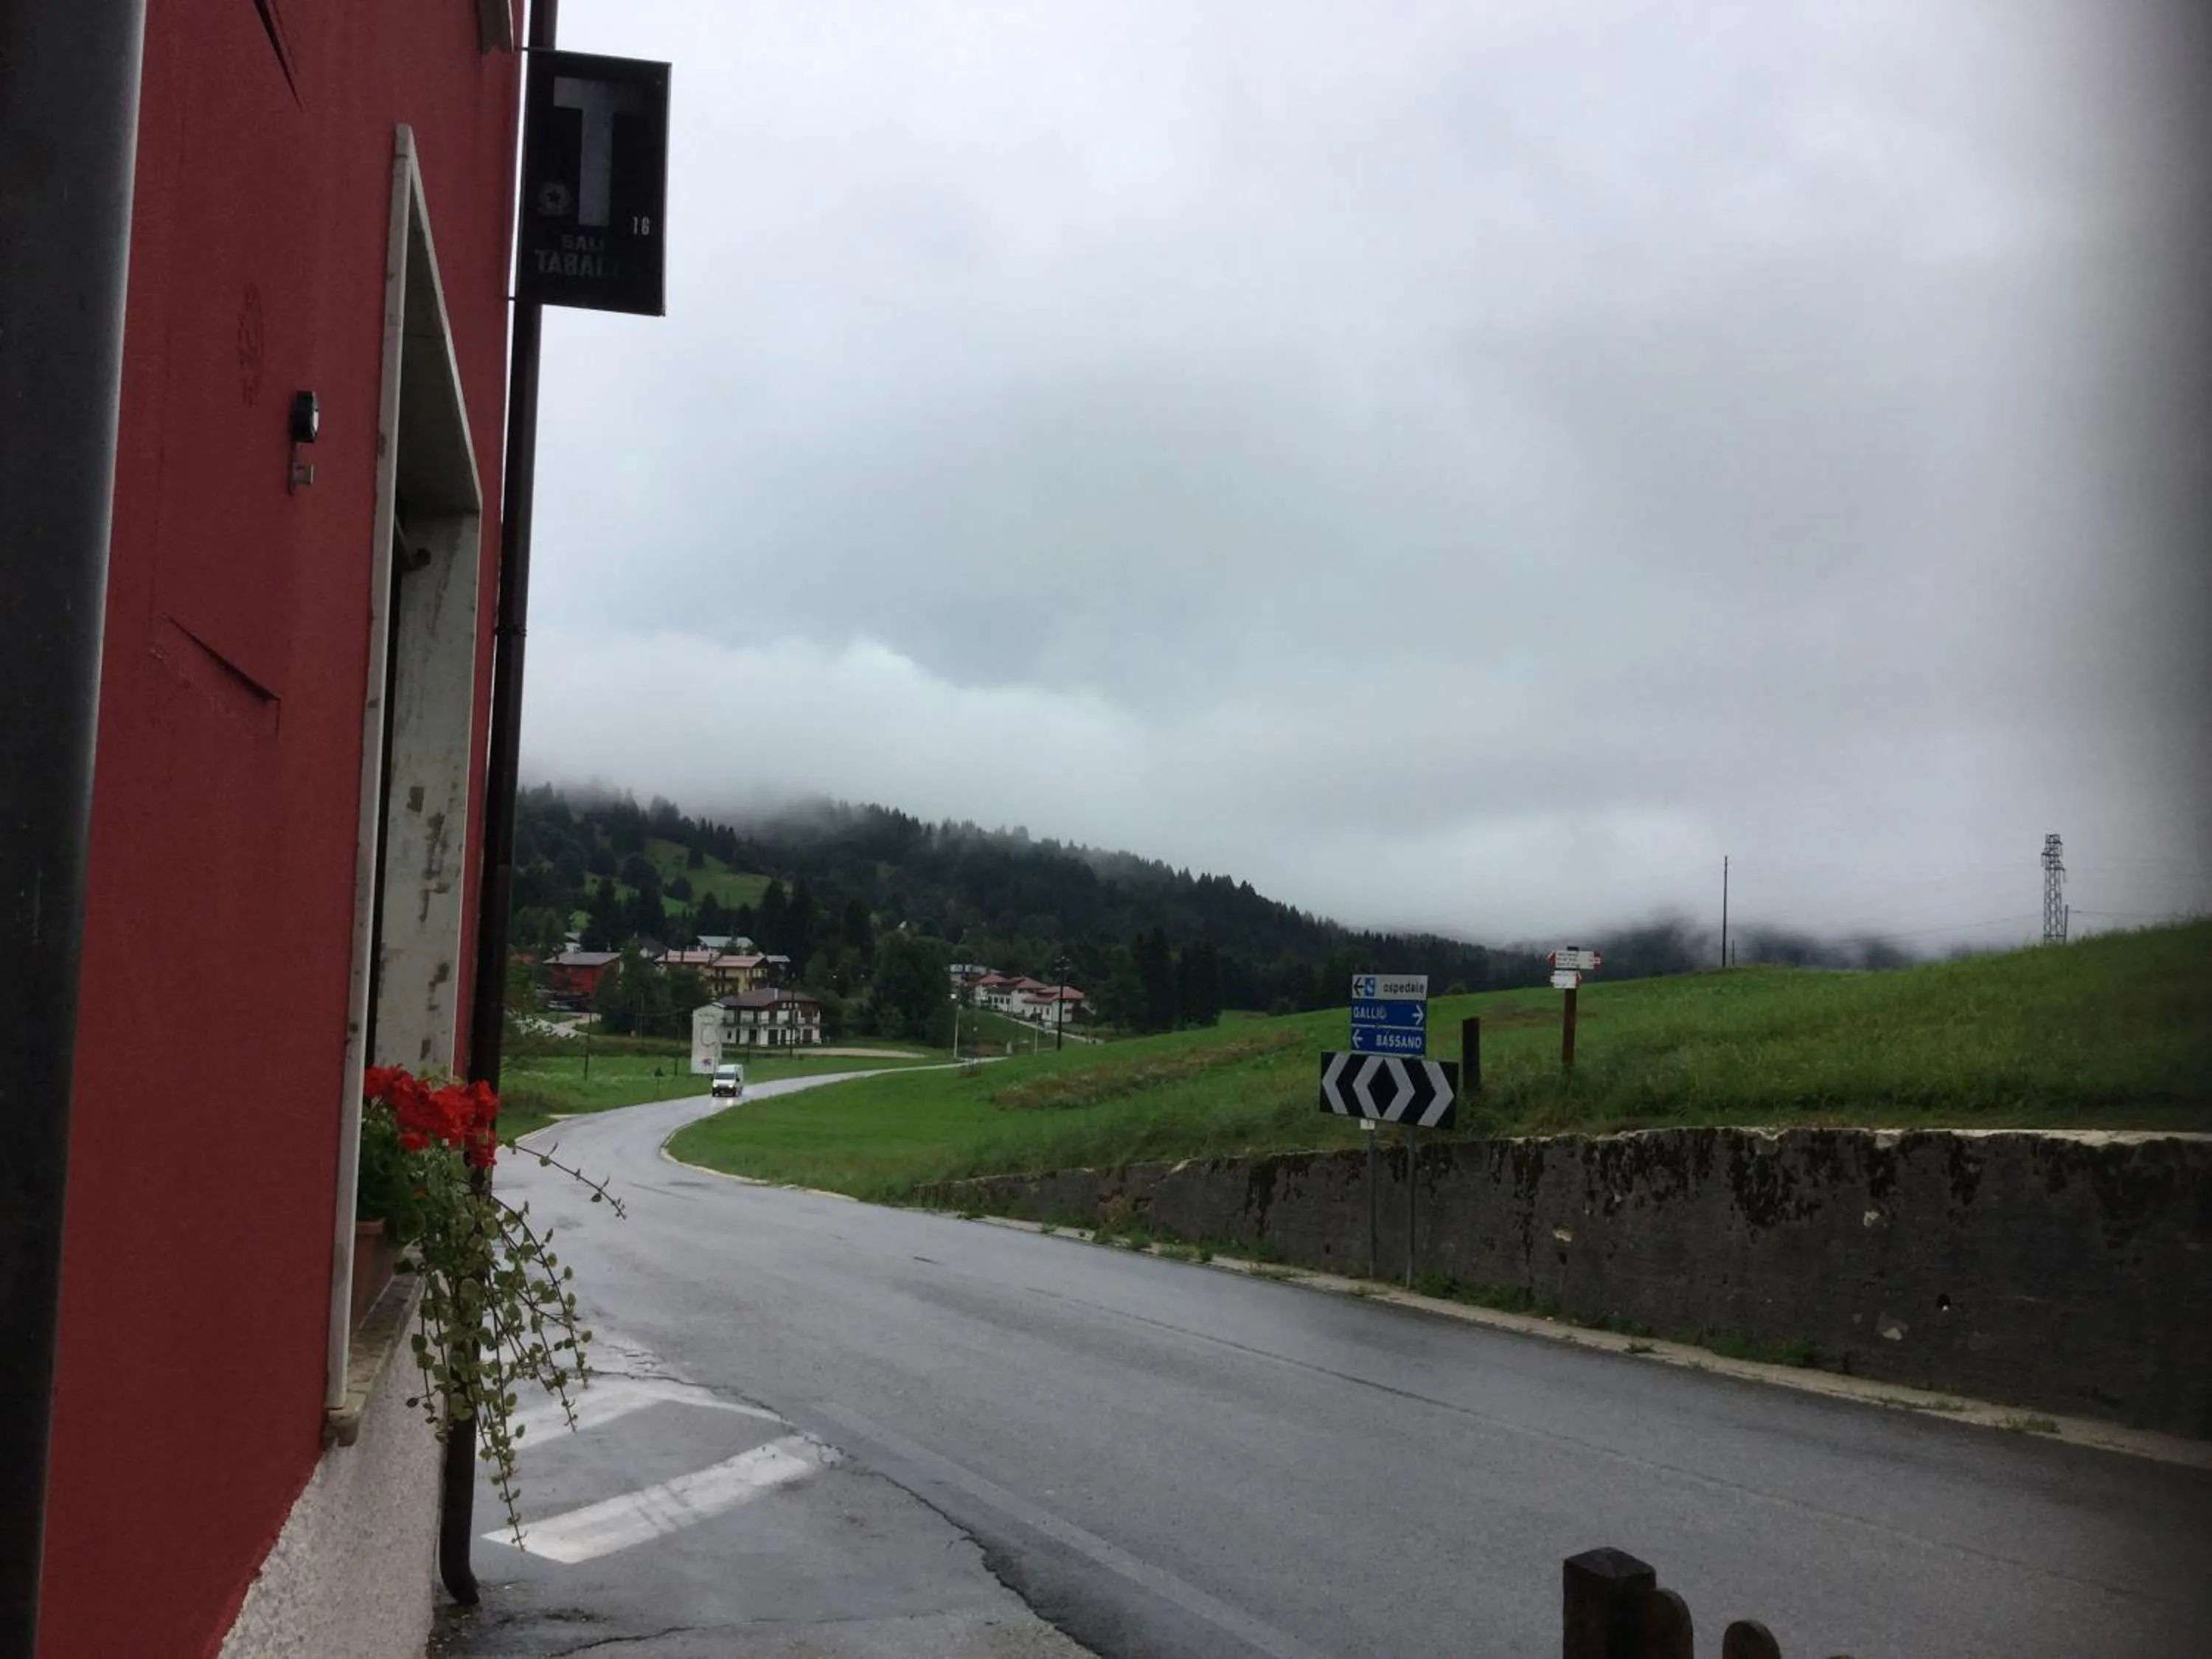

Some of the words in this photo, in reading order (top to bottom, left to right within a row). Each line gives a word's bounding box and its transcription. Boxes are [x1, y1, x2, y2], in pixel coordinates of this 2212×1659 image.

[554, 76, 640, 227] T
[1382, 981, 1425, 995] ospedale
[1354, 1006, 1387, 1020] GALLIO
[1376, 1034, 1422, 1049] BASSANO
